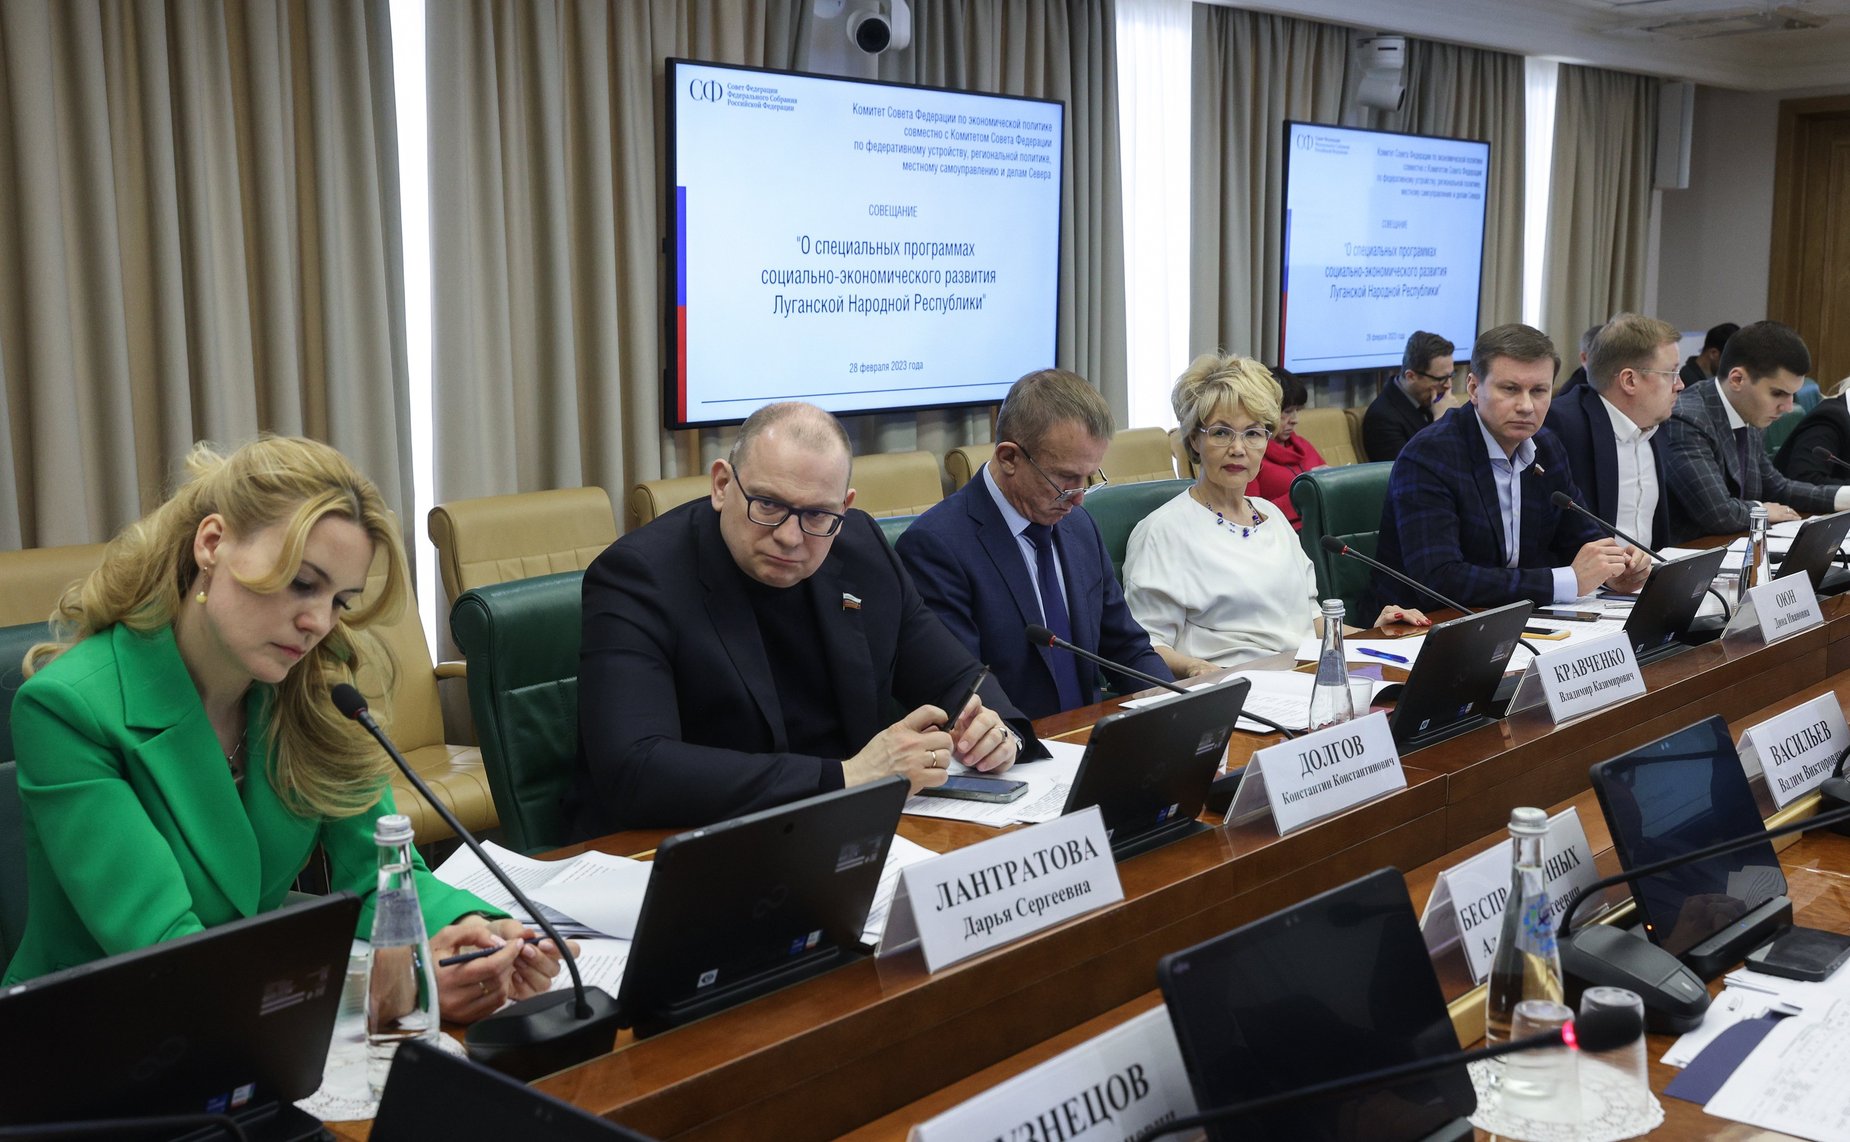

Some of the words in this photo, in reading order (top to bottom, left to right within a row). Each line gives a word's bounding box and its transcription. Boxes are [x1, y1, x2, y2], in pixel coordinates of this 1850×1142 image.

[689, 78, 723, 102] СФ
[727, 82, 745, 92] Совет
[746, 84, 778, 95] Федерации
[727, 91, 769, 103] Федерального
[769, 94, 798, 104] Собрания
[727, 98, 762, 109] Российской
[762, 101, 795, 112] Федерации
[852, 102, 885, 117] Комитет
[887, 106, 914, 120] Совета
[915, 109, 957, 126] Федерации
[957, 114, 967, 125] по
[968, 115, 1021, 129] экономической
[1022, 119, 1053, 133] политике
[904, 126, 943, 139] совместно
[944, 130, 949, 139] с
[950, 128, 989, 143] Комитетом
[990, 132, 1014, 145] Совета
[1015, 135, 1052, 148] Федерации
[854, 140, 864, 151] по
[865, 139, 926, 157] федеративному
[927, 145, 969, 160] устройству,
[970, 148, 1018, 163] региональной
[902, 161, 938, 175] местному
[939, 163, 999, 178] самоуправлению
[1006, 167, 1027, 179] делам
[1028, 167, 1052, 181] Севера
[868, 204, 918, 219] СОВЕЩАНИЕ
[815, 239, 900, 257] специальных
[904, 242, 975, 260] программах
[761, 268, 941, 287] социально-экономического
[945, 269, 997, 287] развития
[773, 295, 844, 318] Луганской
[848, 294, 910, 317] Народной
[914, 293, 986, 315] Республики"
[849, 362, 858, 374] 28
[859, 361, 889, 374] февраля
[891, 360, 907, 372] 2023
[908, 360, 924, 372] года
[1775, 589, 1798, 608] ОЮН
[1553, 647, 1626, 684] КРАВЧЕНКО
[1558, 685, 1593, 703] Владимир
[1592, 672, 1635, 692] Казимирович
[1769, 720, 1832, 767] ВАСИЛЬЕВ
[1298, 734, 1365, 779] ДОЛГОВ
[1281, 780, 1333, 805] Константин
[1333, 757, 1395, 787] Константинович
[935, 835, 1100, 912] ЛАНТРАТОВА
[963, 906, 1014, 941] Дарья
[1015, 878, 1092, 918] Сергеевна
